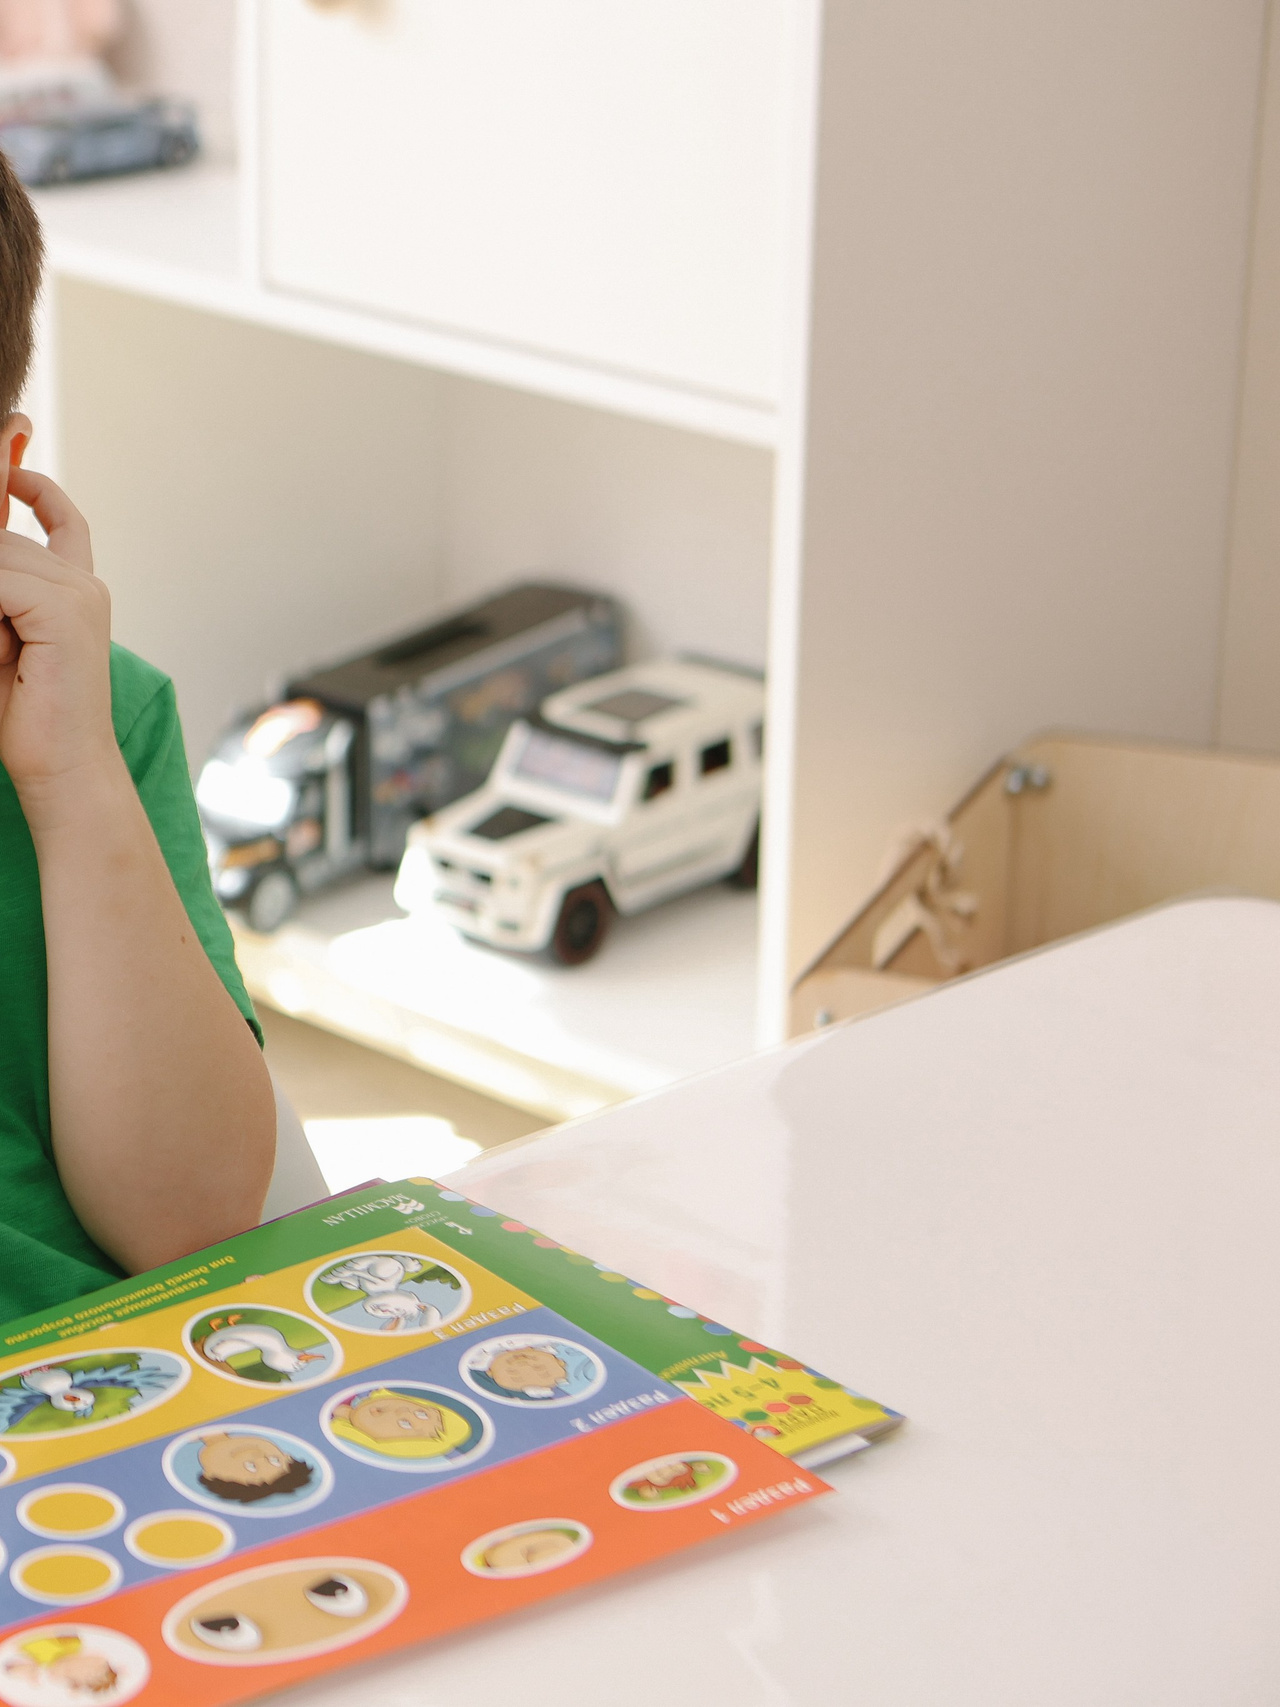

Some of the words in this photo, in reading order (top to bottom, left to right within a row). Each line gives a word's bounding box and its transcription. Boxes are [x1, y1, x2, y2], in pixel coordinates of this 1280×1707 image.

[320, 1192, 409, 1226] MACMILLAN
[164, 1264, 208, 1288] детей
[208, 1254, 235, 1269] для
[73, 1281, 163, 1320] дошкольного
[114, 1276, 207, 1318] Развивающее
[3, 1315, 73, 1345] возраста
[56, 1311, 113, 1337] пособие
[448, 1300, 526, 1332] Раздел
[430, 1325, 448, 1340] 3
[586, 1388, 669, 1424] Раздел
[568, 1416, 592, 1433] 2
[724, 1476, 812, 1515] Раздел
[708, 1507, 730, 1524] 1
